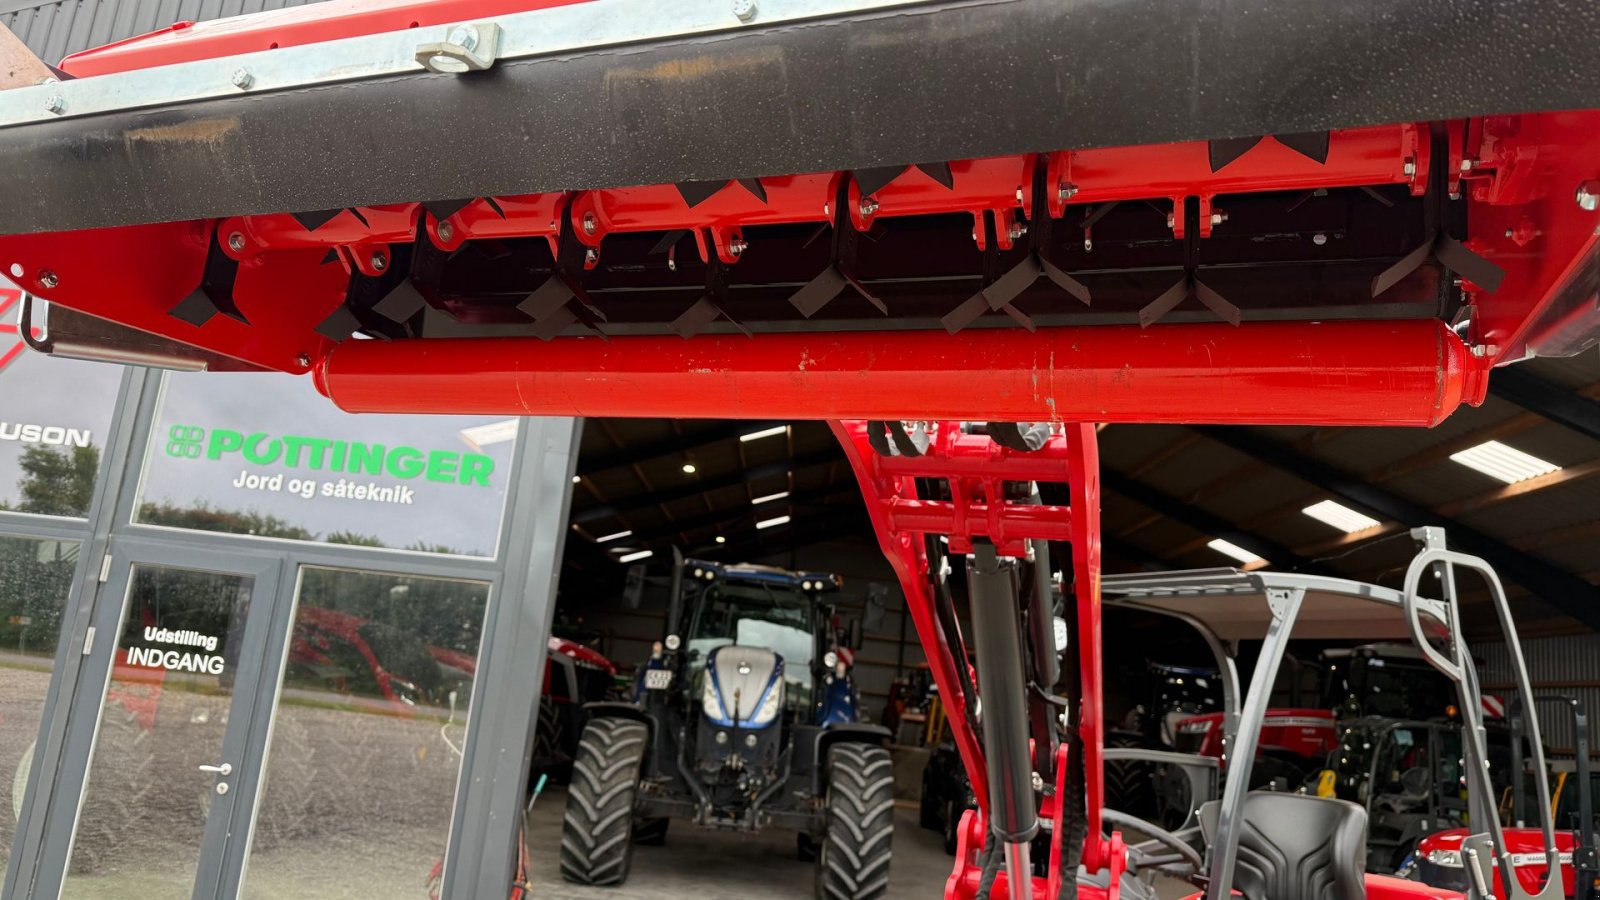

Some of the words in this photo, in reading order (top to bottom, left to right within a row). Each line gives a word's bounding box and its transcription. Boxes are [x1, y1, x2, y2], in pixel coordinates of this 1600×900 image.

[0, 422, 91, 447] USON
[233, 470, 283, 491] Jord
[288, 479, 316, 498] og
[321, 479, 414, 504] såteknik
[144, 626, 218, 651] Udstilling
[126, 647, 225, 674] INDGANG
